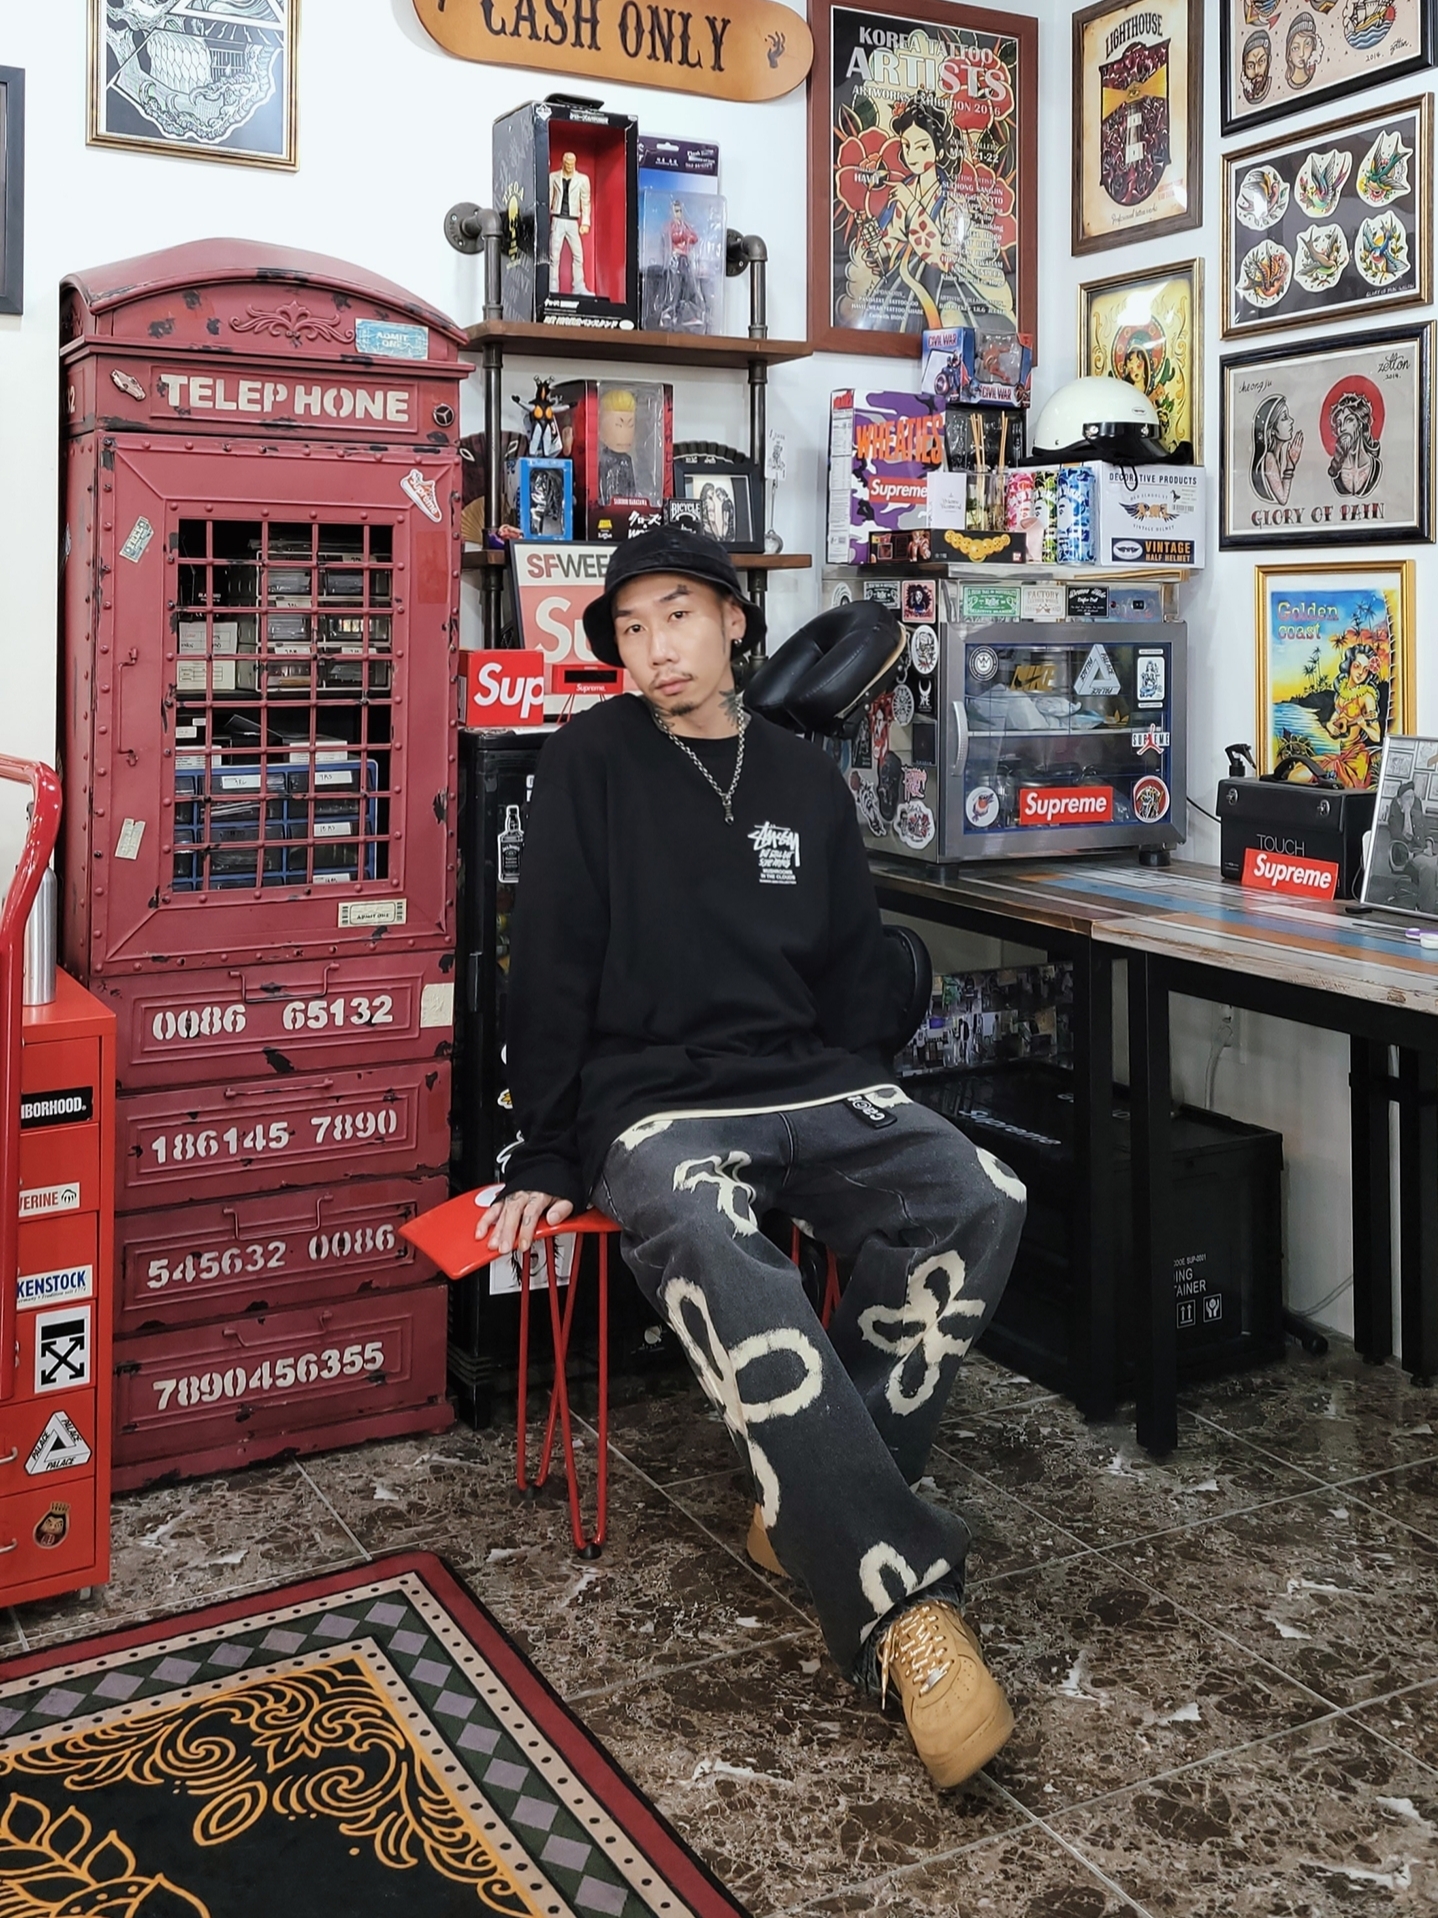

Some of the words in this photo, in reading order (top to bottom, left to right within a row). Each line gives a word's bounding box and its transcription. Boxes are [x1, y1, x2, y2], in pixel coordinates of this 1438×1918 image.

[479, 0, 601, 51] CASH
[618, 0, 732, 72] ONLY
[859, 26, 921, 52] KOREA
[925, 38, 994, 65] TATTOO
[1105, 12, 1163, 60] LIGHTHOUSE
[845, 46, 1007, 102] ARTISTS
[852, 85, 911, 102] ARTWORKS
[914, 96, 972, 112] EXHIBITION
[974, 102, 1001, 116] 2016
[972, 151, 999, 163] 21-22
[376, 331, 409, 341] ADMIT
[928, 334, 943, 348] CIVIL
[942, 333, 957, 346] WAR
[160, 373, 409, 423] TELEPHONE
[982, 385, 997, 399] CIVIL
[997, 386, 1012, 400] WAR
[856, 413, 944, 464] WHEATIES
[870, 478, 928, 501] Supreme
[1109, 472, 1156, 483] DECORTIVE
[1159, 475, 1197, 485] PRODUCTS
[409, 477, 438, 515] Supreme
[671, 502, 701, 522] BICYCLE
[1251, 507, 1305, 529] GLORY
[1311, 505, 1334, 522] OF
[1339, 503, 1385, 521] PAIN
[1133, 523, 1154, 532] VINTAGE
[1145, 540, 1191, 554] VINTAGE
[1145, 553, 1163, 562] HALF
[1164, 553, 1191, 563] HELMET
[1027, 590, 1060, 600] FACTORY
[1277, 601, 1339, 623] Golden
[1277, 622, 1322, 641] coast
[1009, 664, 1058, 693] NIKE
[1132, 733, 1170, 747] SUPEME
[1024, 792, 1107, 820] Supreme
[1256, 833, 1305, 857] TOUCH
[1253, 853, 1332, 889] Supreme
[152, 1004, 247, 1042] 0086
[282, 995, 394, 1031] 65132
[151, 1120, 290, 1165] 186145
[311, 1108, 397, 1144] 7890
[147, 1240, 287, 1290] 545632
[308, 1223, 396, 1262] 0086
[1174, 1267, 1194, 1283] ING
[152, 1342, 386, 1411] 7890456355
[62, 1418, 81, 1442] PALACE
[31, 1430, 50, 1461] PALACE
[46, 1456, 76, 1471] PALACE
